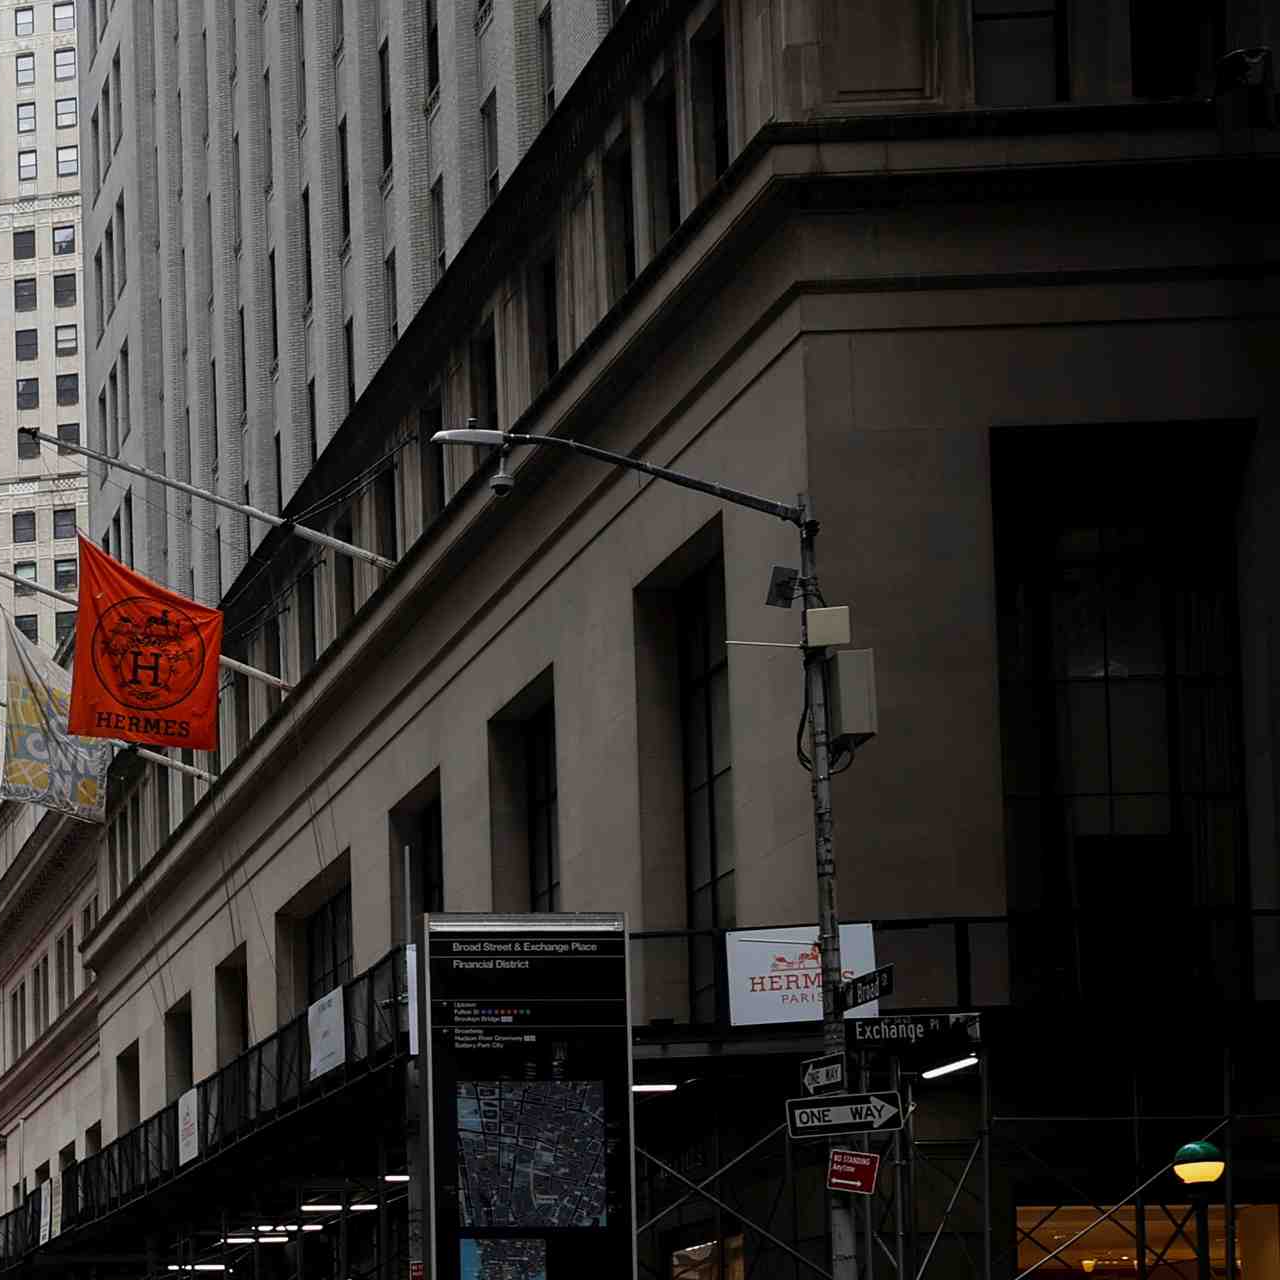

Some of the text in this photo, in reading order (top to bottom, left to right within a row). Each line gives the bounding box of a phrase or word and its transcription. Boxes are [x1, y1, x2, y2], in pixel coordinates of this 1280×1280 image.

[95, 711, 191, 737] HERMES
[452, 942, 598, 953] Broad Street & Exchange Place
[452, 959, 529, 969] Financial District
[749, 970, 855, 993] HERMS
[856, 973, 880, 1004] Broad
[782, 991, 824, 1004] PARIS
[855, 1021, 925, 1043] Exchange
[799, 1104, 886, 1125] ONE WAY
